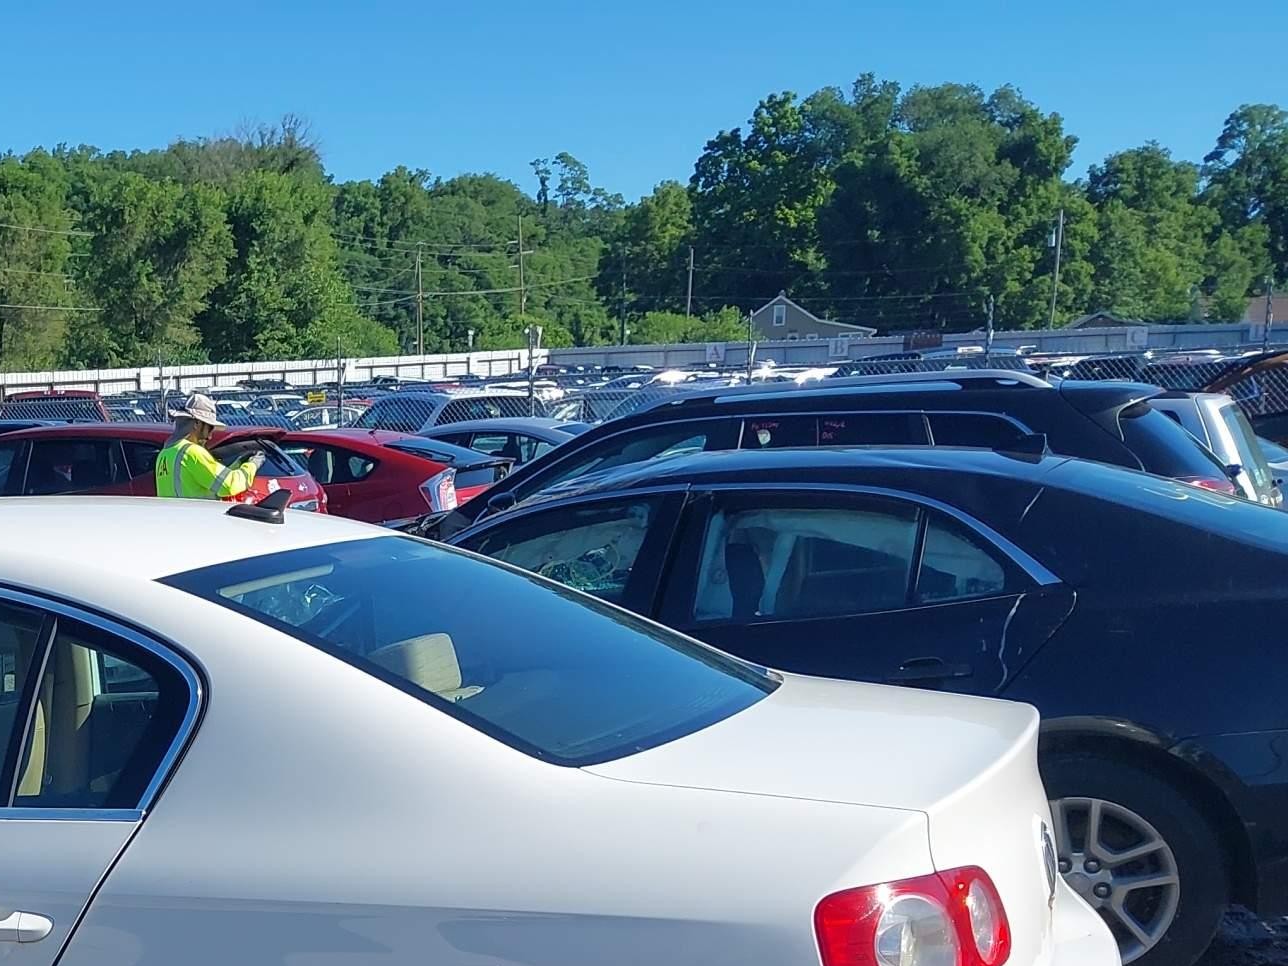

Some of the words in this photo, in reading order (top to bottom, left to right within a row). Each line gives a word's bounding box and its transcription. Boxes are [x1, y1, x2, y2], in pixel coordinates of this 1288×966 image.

[1131, 329, 1145, 344] C
[710, 346, 721, 359] A
[833, 339, 845, 354] B
